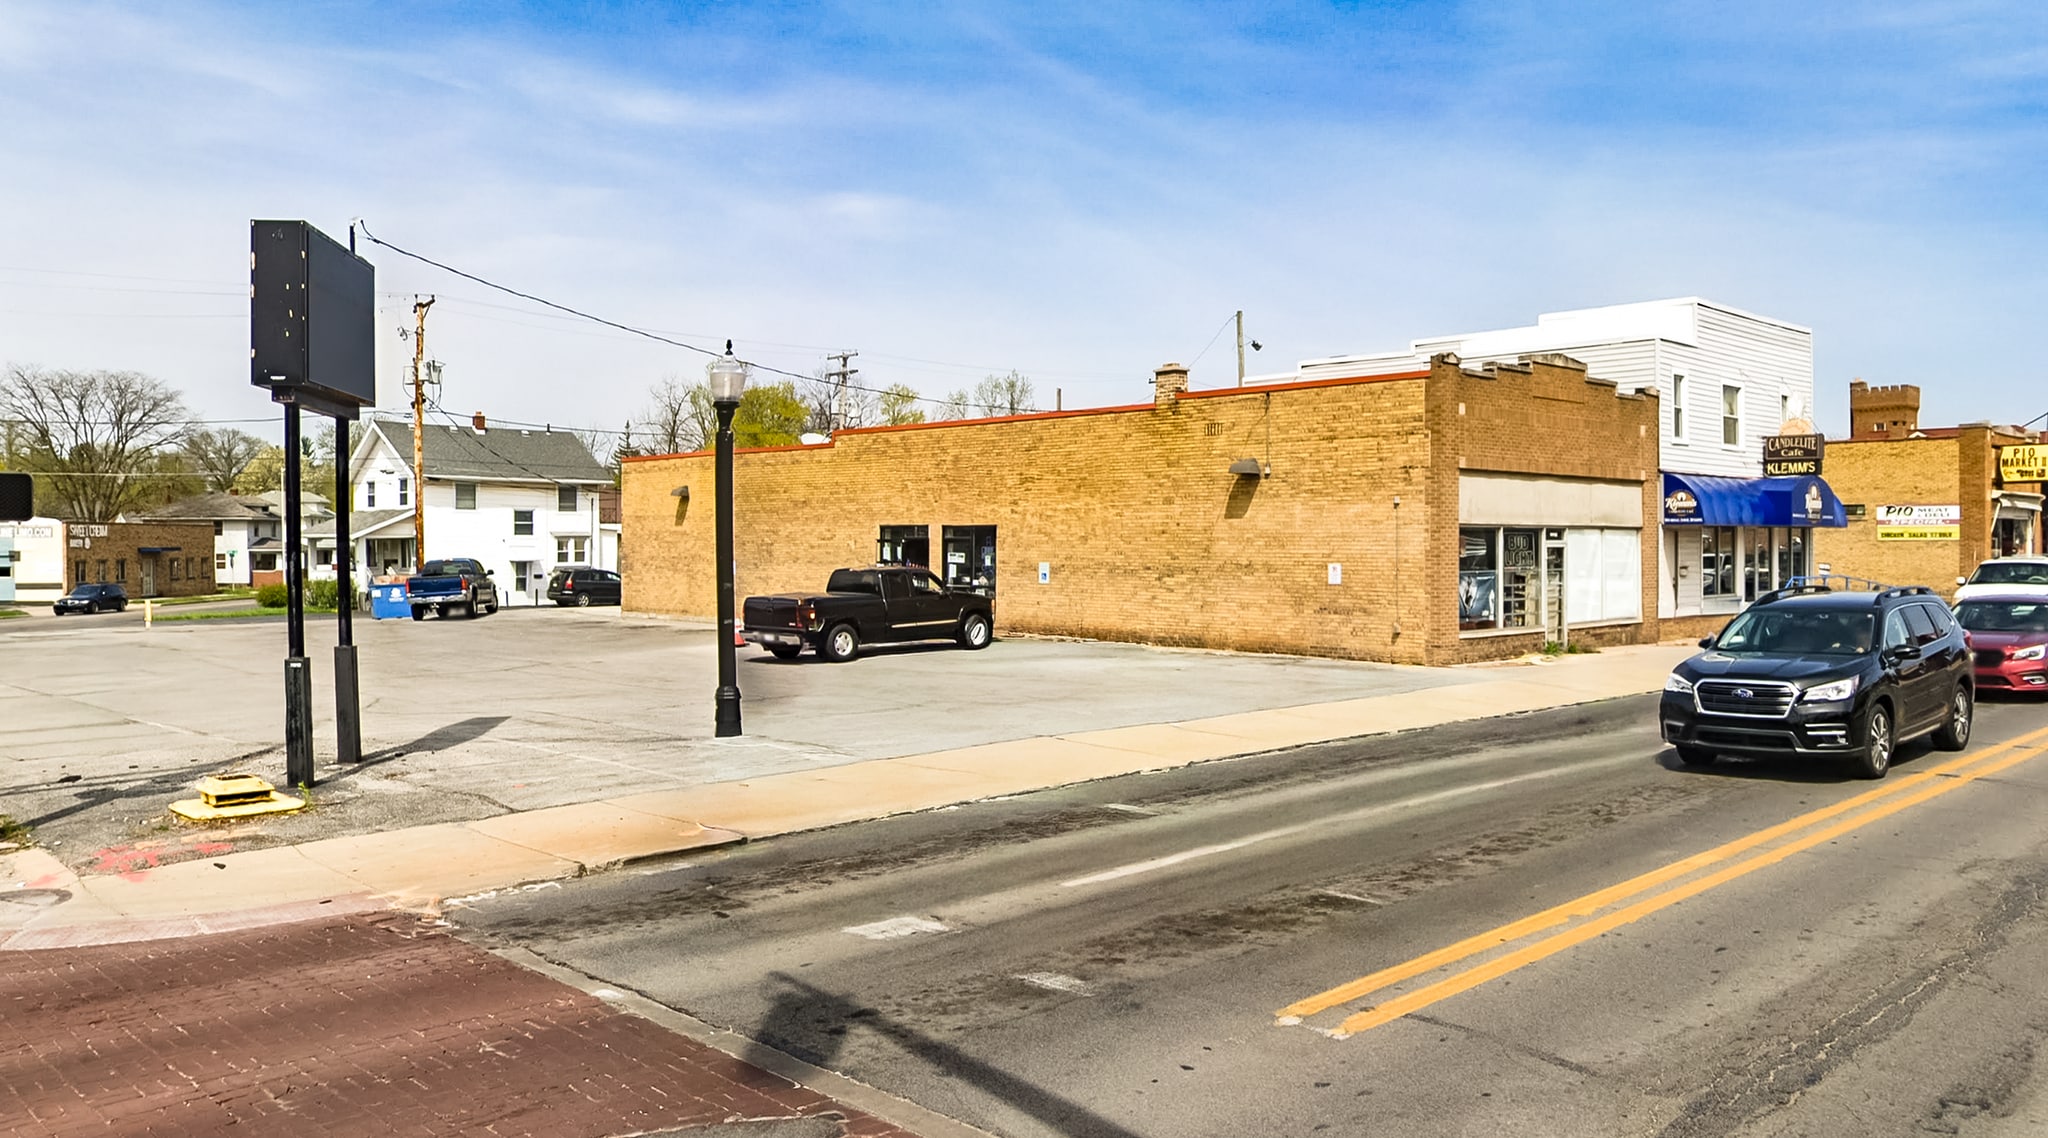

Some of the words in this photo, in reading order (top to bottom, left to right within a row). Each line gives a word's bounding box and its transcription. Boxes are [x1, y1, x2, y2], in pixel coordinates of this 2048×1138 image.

[1768, 437, 1817, 451] CANDLELITE
[1781, 448, 1804, 456] Cafe
[2013, 447, 2035, 457] PIO
[1767, 461, 1816, 474] KLEMM'S
[2002, 457, 2038, 467] MARKET
[1885, 505, 1914, 516] PIO
[69, 525, 89, 536] SWEET
[1508, 535, 1530, 550] BUD
[1504, 550, 1534, 566] LIGHT
